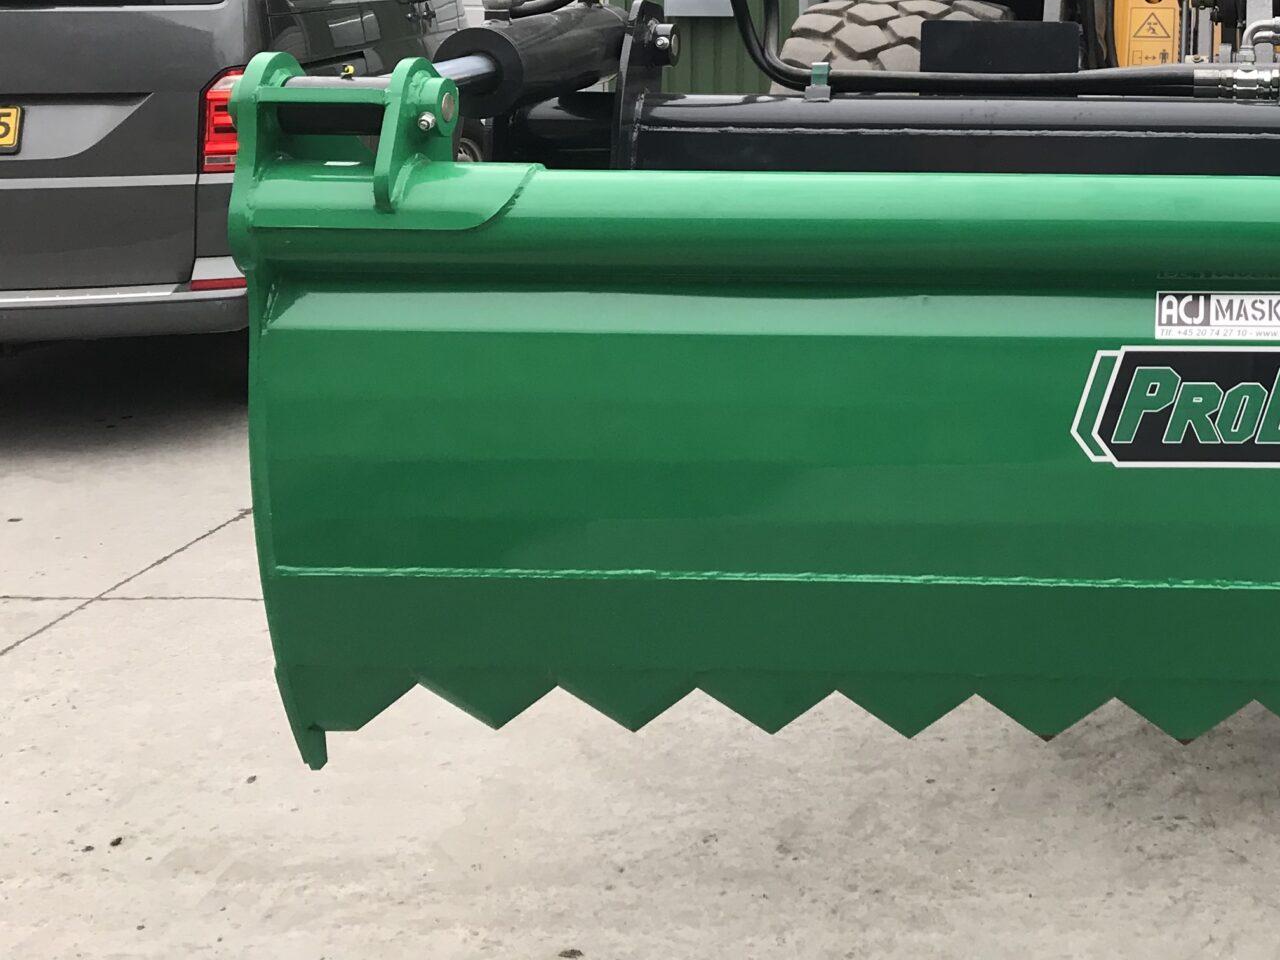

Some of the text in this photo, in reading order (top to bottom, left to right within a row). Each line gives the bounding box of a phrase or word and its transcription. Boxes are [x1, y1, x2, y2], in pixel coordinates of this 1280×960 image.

[1161, 295, 1205, 325] ACJ
[1178, 328, 1193, 336] +45
[1210, 329, 1220, 337] 74
[1223, 329, 1234, 337] 27
[1237, 329, 1247, 337] 10
